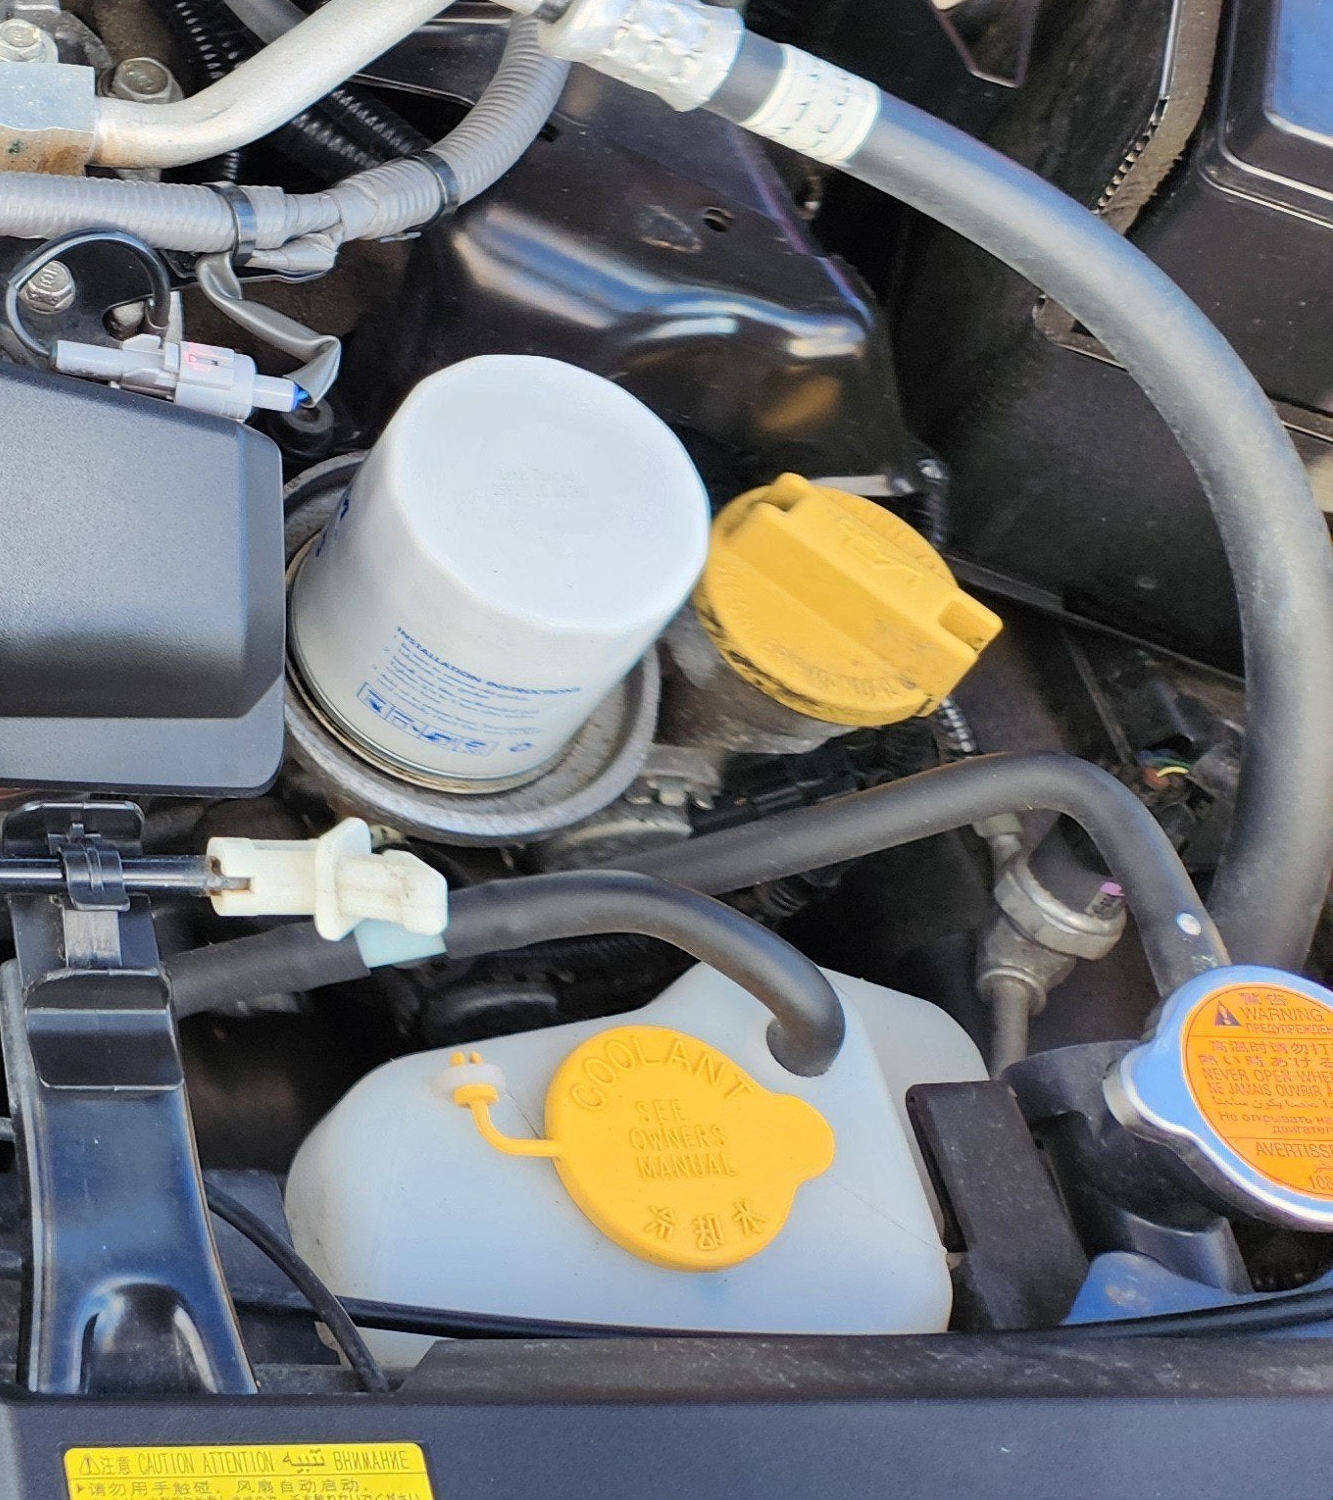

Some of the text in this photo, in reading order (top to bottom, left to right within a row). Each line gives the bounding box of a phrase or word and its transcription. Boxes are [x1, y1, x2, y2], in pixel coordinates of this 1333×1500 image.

[1240, 1006, 1325, 1022] WARNING
[569, 1035, 755, 1111] COOLANT
[1201, 1067, 1333, 1083] NEVER OPEN WHE
[1207, 1082, 1225, 1095] NE
[1229, 1082, 1272, 1096] JAMAIS
[1275, 1084, 1323, 1098] OUVRIR
[636, 1098, 687, 1124] SEE
[629, 1125, 727, 1151] OWNERS
[636, 1154, 739, 1181] MANUAL
[101, 1455, 130, 1475] 注意
[138, 1452, 194, 1474] CAUTION
[202, 1450, 274, 1473] ATTENTION
[333, 1450, 410, 1472] ВНИМАНИЕ
